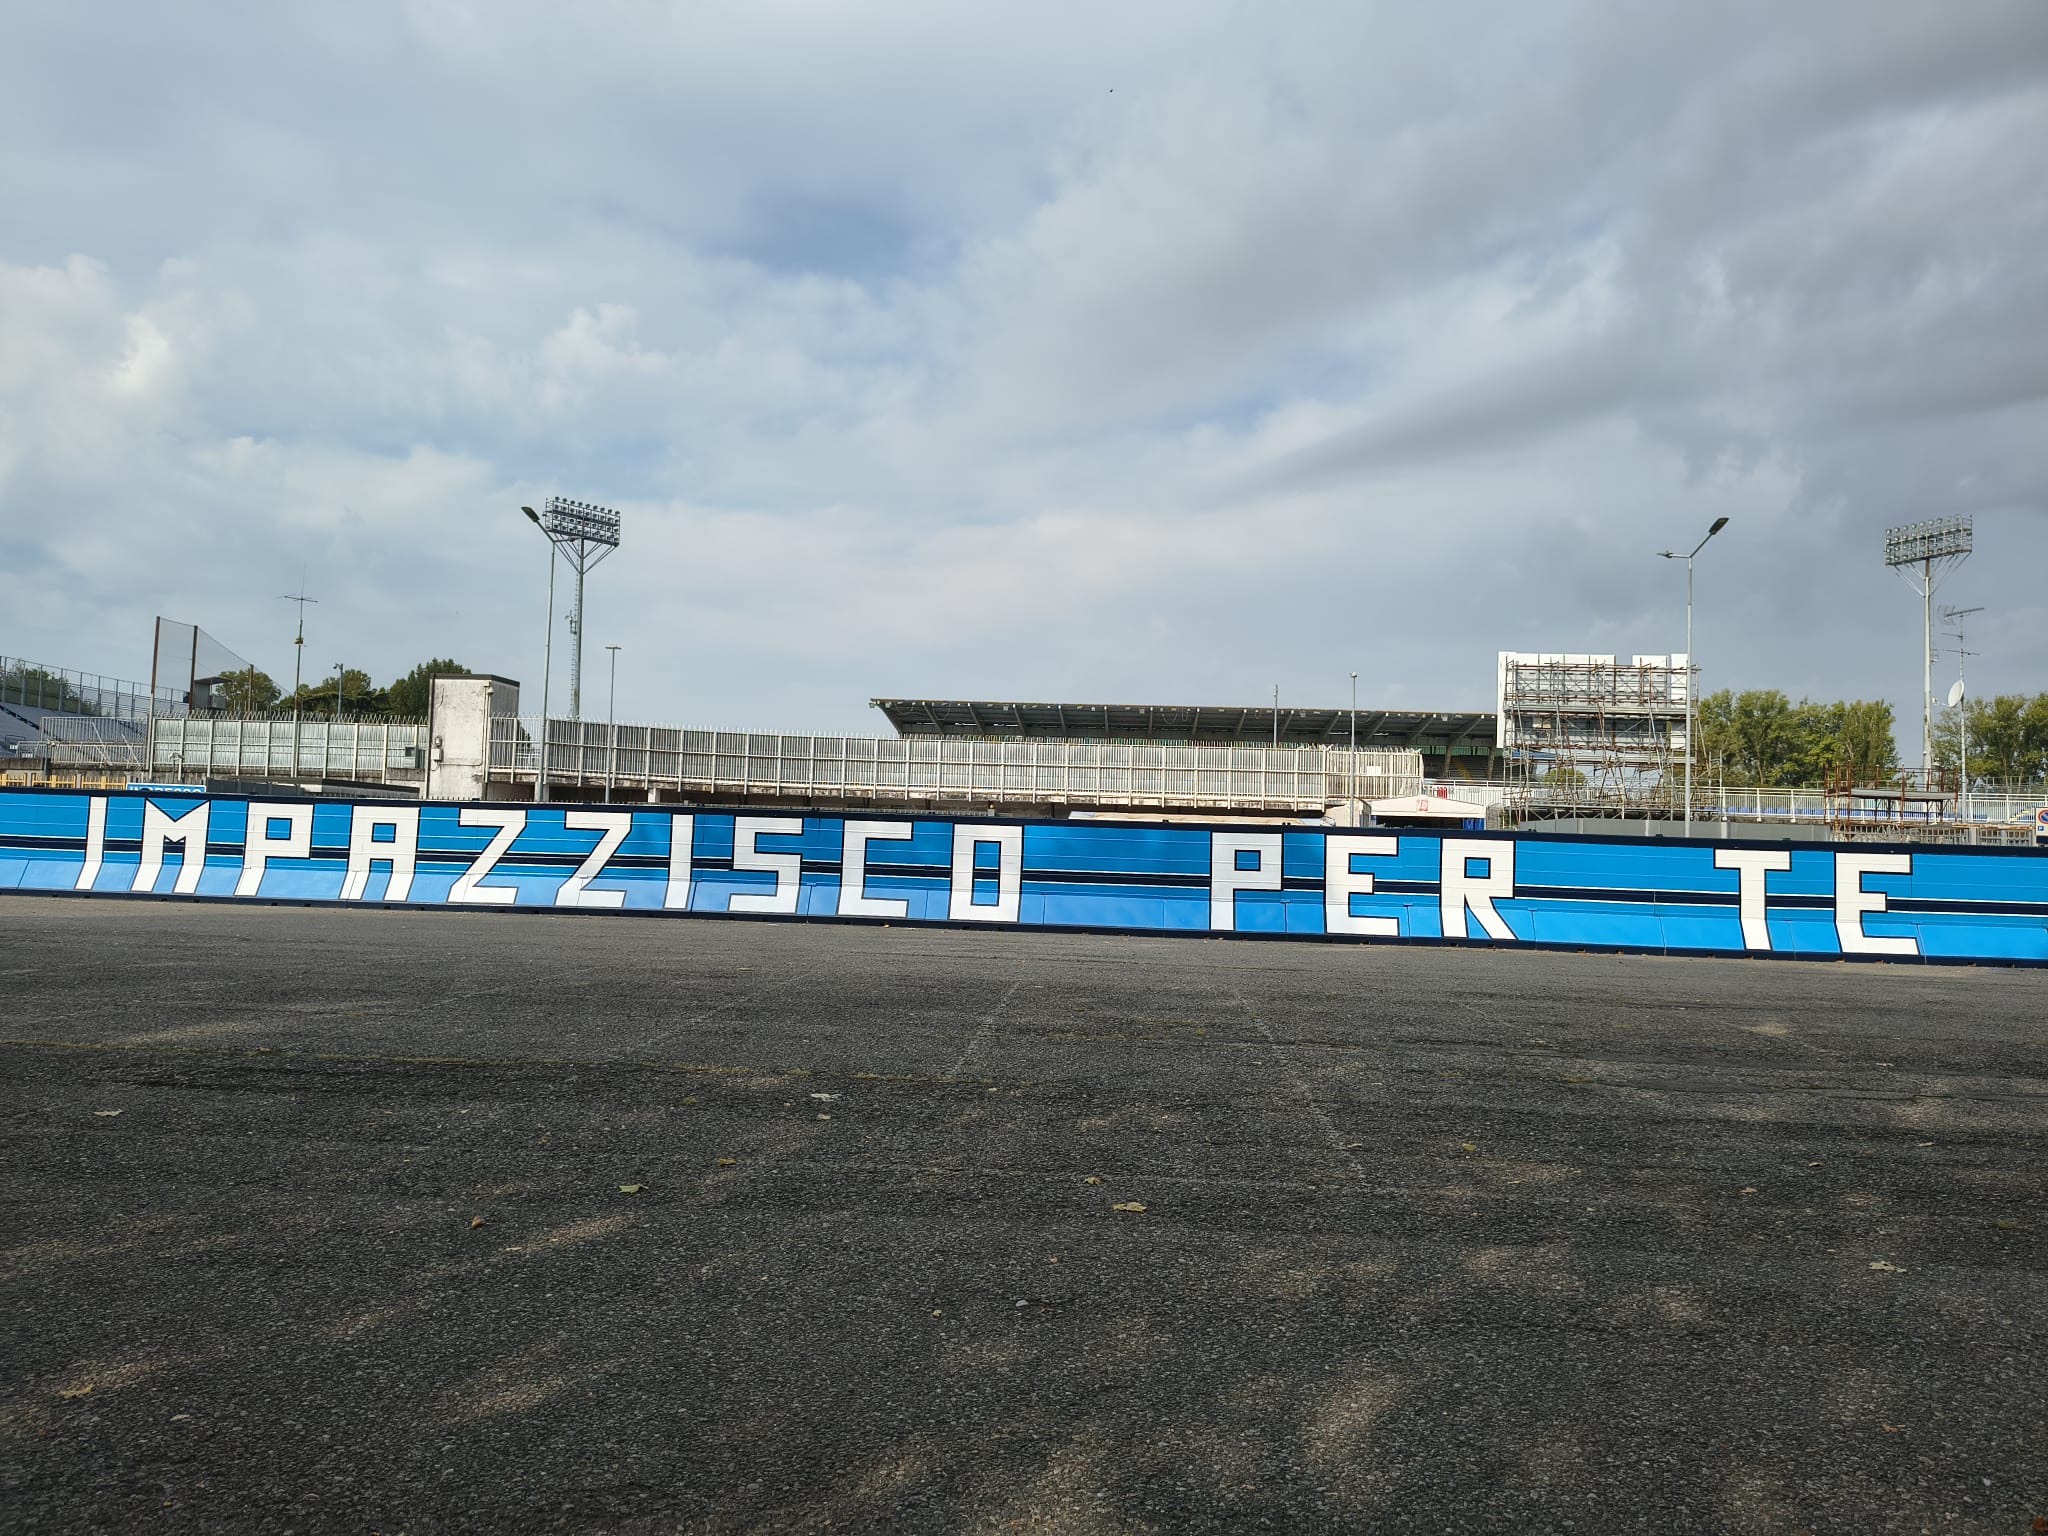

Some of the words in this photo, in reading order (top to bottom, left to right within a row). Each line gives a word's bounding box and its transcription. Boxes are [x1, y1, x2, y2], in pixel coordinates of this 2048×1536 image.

[75, 796, 1023, 922] IMPAZZISCO
[1210, 832, 1516, 940] PER
[1714, 849, 1919, 956] TE
